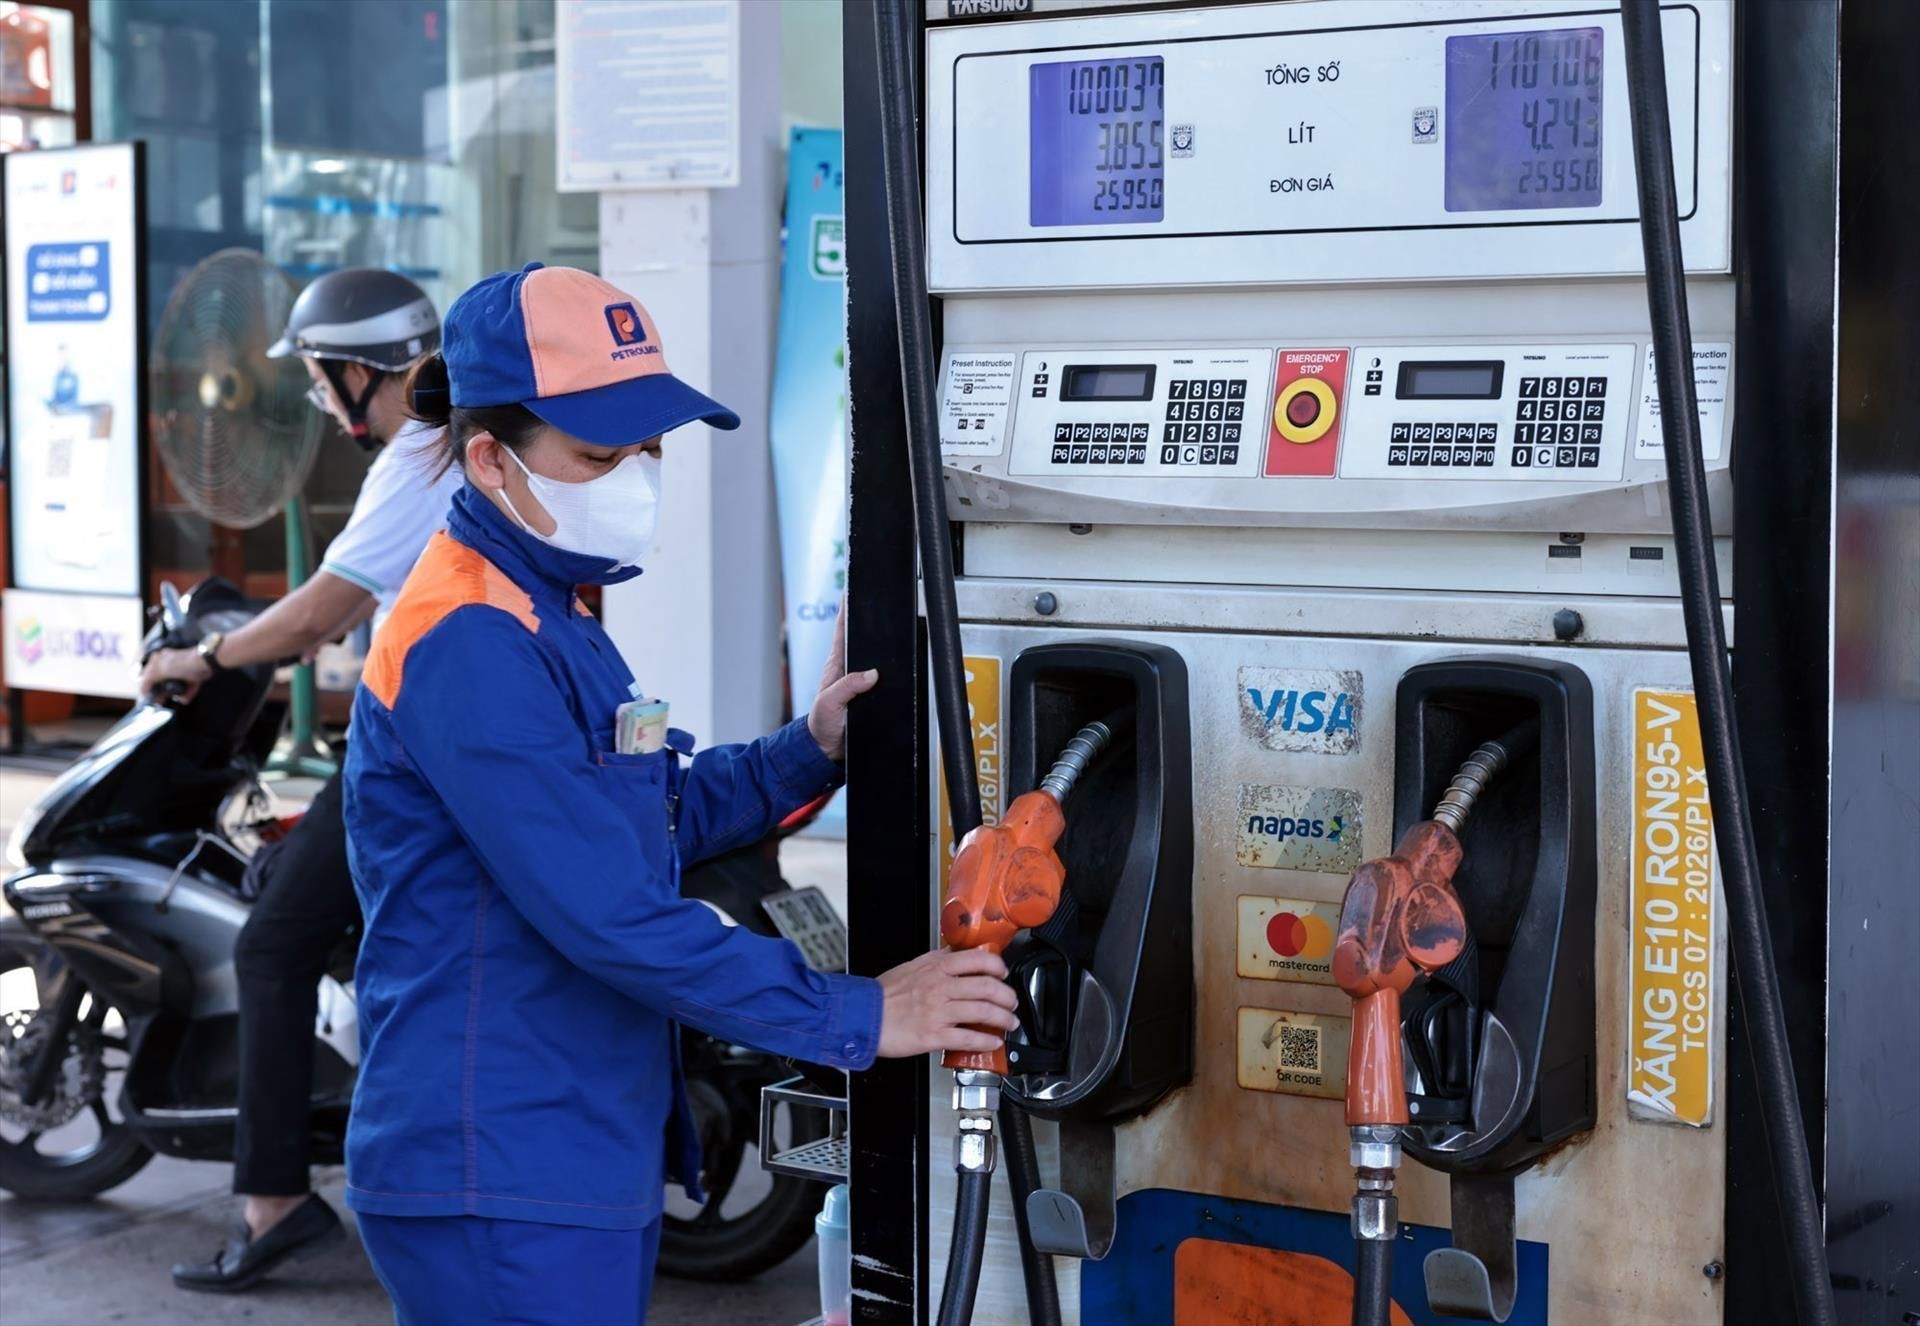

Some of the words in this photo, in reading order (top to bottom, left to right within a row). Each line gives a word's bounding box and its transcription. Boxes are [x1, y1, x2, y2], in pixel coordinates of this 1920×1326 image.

[951, 0, 1029, 15] TATSUNO
[1265, 63, 1310, 85] TỔNG
[1317, 60, 1340, 82] SỐ
[1288, 121, 1315, 144] LÍT
[1270, 177, 1303, 193] ĐƠN
[1306, 173, 1334, 192] GIÁ
[1519, 159, 1598, 193] 25950
[1093, 178, 1163, 210] 25950
[1286, 354, 1340, 363] EMERGENCY
[1690, 350, 1727, 358] truction
[1300, 365, 1323, 374] STOP
[1174, 383, 1184, 397] 7
[1192, 383, 1203, 397] 8
[1212, 382, 1222, 397] 9
[1230, 384, 1243, 394] F1
[1525, 380, 1536, 395] 7
[1546, 380, 1557, 395] 8
[1568, 380, 1579, 395] 9
[1589, 382, 1602, 393] F1
[1170, 404, 1180, 419] 4
[1189, 404, 1200, 419] 5
[1209, 404, 1220, 419] 6
[1227, 406, 1241, 416] F2
[1521, 403, 1532, 418] 4
[1543, 403, 1554, 419] 5
[1566, 403, 1577, 419] 6
[1586, 405, 1601, 416] F2
[1056, 427, 1070, 438] P1
[1075, 427, 1090, 438] P2
[1094, 427, 1109, 439] P3
[1113, 427, 1127, 438] P4
[1132, 427, 1147, 439] P5
[1168, 426, 1176, 440] 1
[1186, 426, 1197, 440] 2
[1206, 426, 1217, 441] 3
[1225, 428, 1238, 438] F3
[1393, 427, 1408, 439] P1
[1414, 427, 1431, 439] P2
[1436, 427, 1452, 439] P3
[1457, 427, 1473, 439] P4
[1479, 427, 1495, 440] P5
[1520, 426, 1528, 441] 1
[1540, 426, 1552, 442] 2
[1563, 426, 1574, 442] 3
[1584, 428, 1598, 439] F3
[1053, 448, 1068, 460] P6
[1072, 448, 1087, 459] P7
[1091, 448, 1106, 460] P8
[1110, 449, 1125, 460] P9
[1128, 449, 1145, 460] P10
[1164, 447, 1175, 462] 0
[1183, 447, 1195, 462] C
[1222, 450, 1235, 460] F4
[1390, 449, 1406, 462] P6
[1411, 449, 1428, 462] P7
[1433, 450, 1449, 462] P8
[1454, 450, 1471, 463] P9
[1475, 450, 1494, 463] P10
[1516, 449, 1527, 465] 0
[1537, 448, 1551, 465] C
[1582, 452, 1596, 462] F4
[1247, 688, 1352, 733] VISA
[979, 722, 998, 828] 026/PLX
[1645, 699, 1681, 886] RON95-V
[1248, 815, 1324, 843] napas
[1685, 766, 1710, 910] 2026/PLX
[1645, 899, 1679, 974] E10
[1684, 928, 1706, 961] 07
[1269, 958, 1330, 973] mastercard
[1683, 971, 1706, 1053] TCCS
[1277, 1072, 1292, 1084] QR
[1294, 1073, 1322, 1086] CODE
